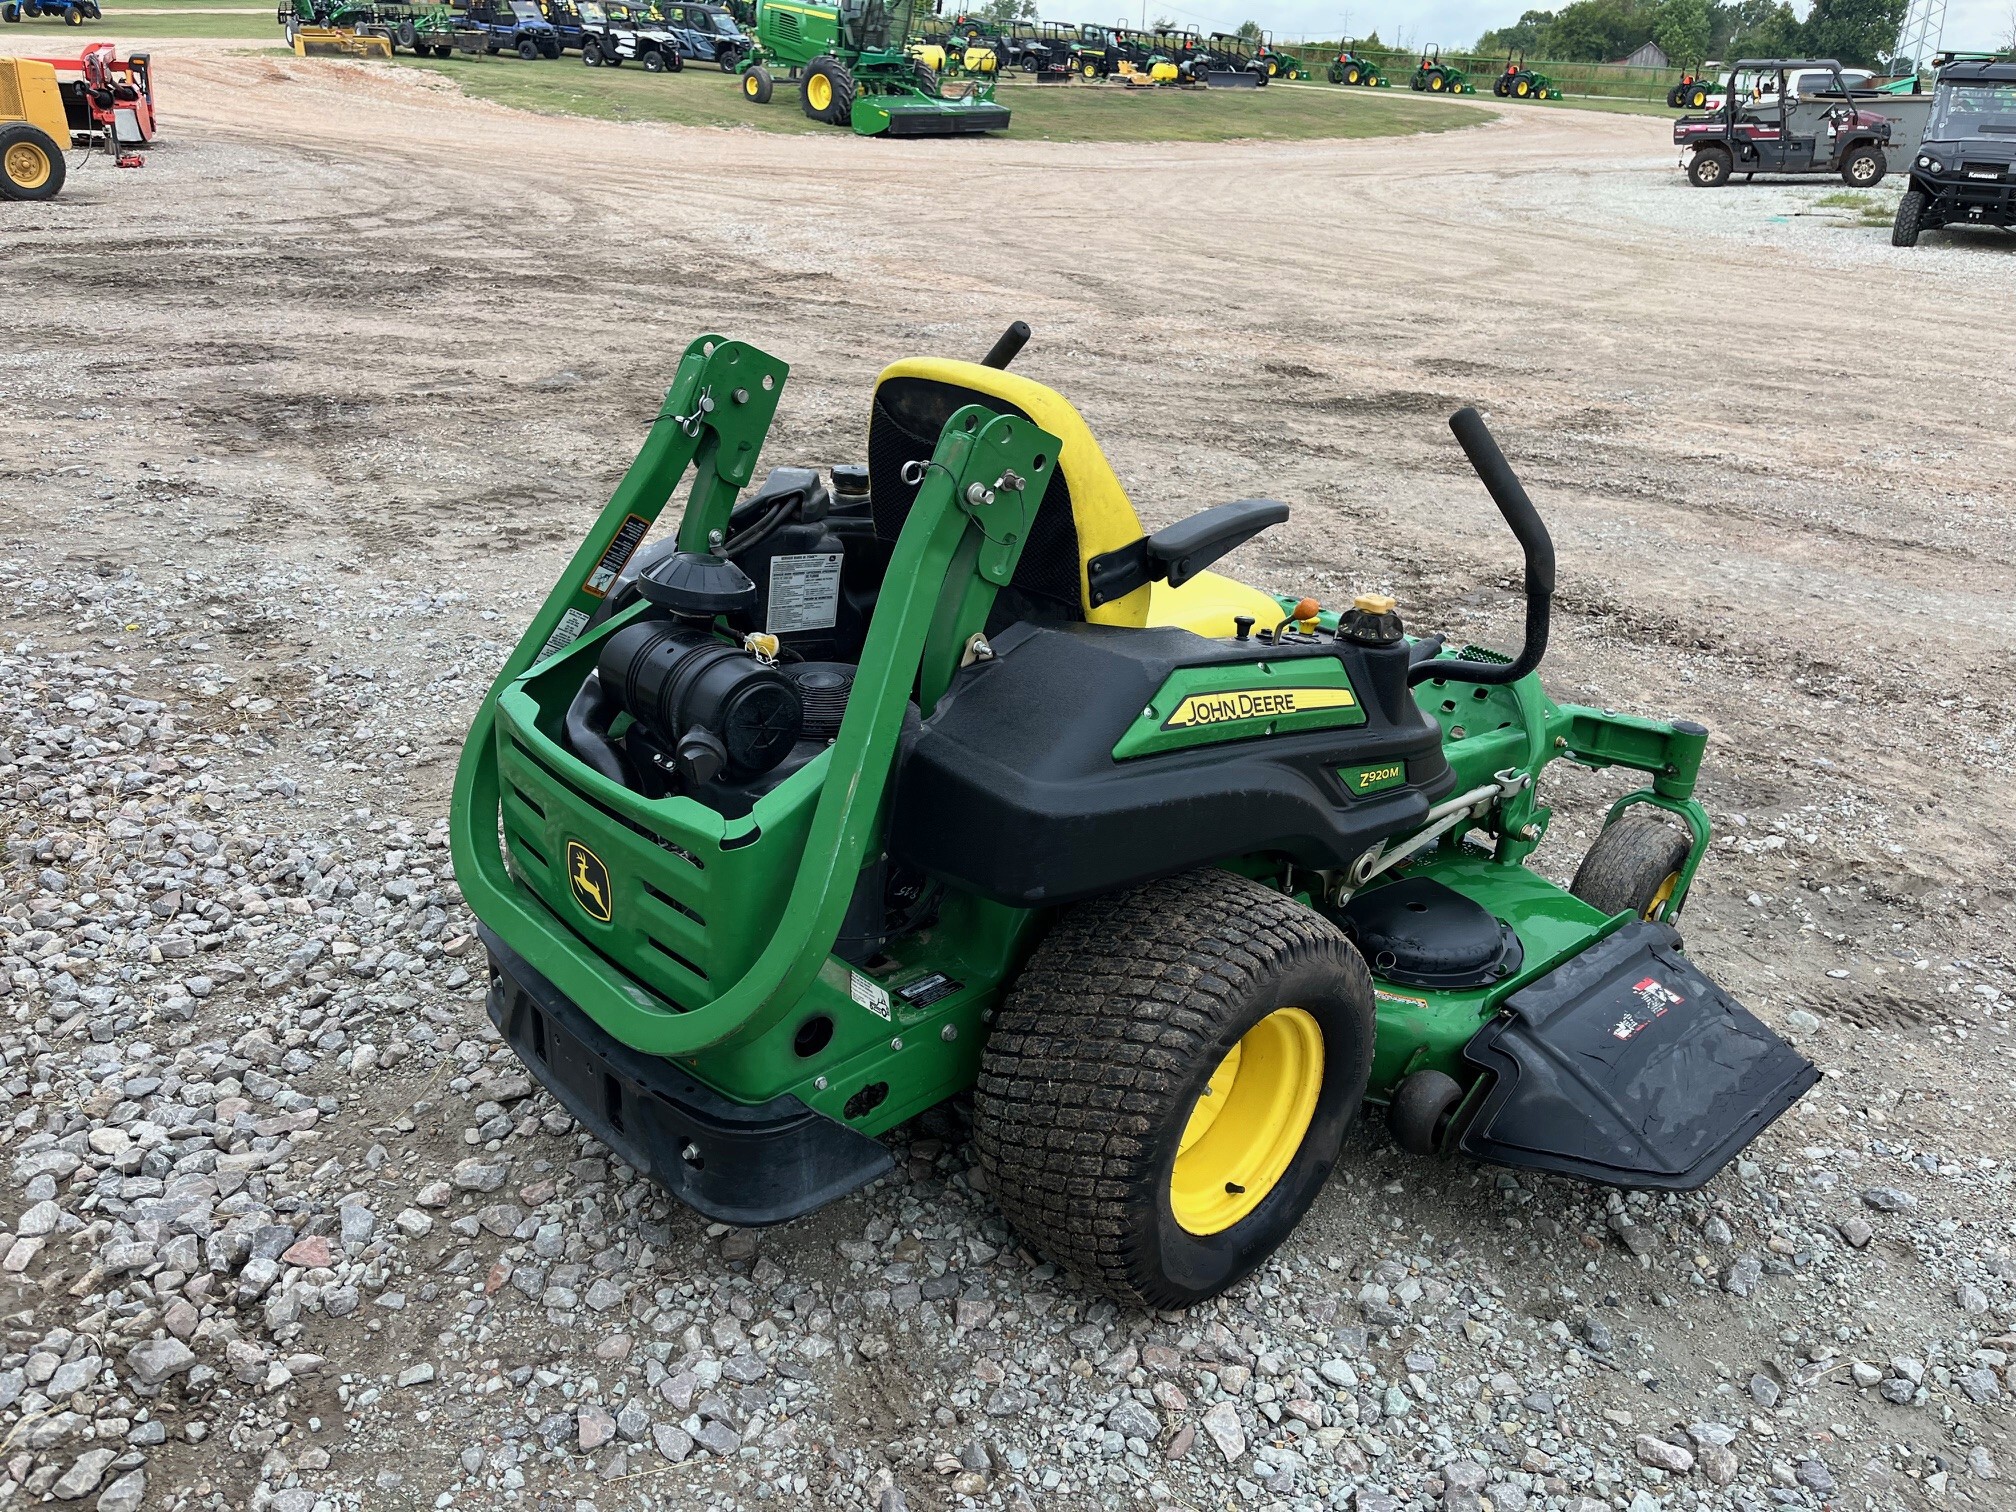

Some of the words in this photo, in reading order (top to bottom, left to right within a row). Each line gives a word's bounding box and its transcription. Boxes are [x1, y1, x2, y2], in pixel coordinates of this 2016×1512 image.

[1968, 171, 1998, 180] Kawasaki
[1187, 700, 1237, 722] JOHN
[1238, 694, 1296, 714] DEERE
[1360, 766, 1399, 788] Z920M
